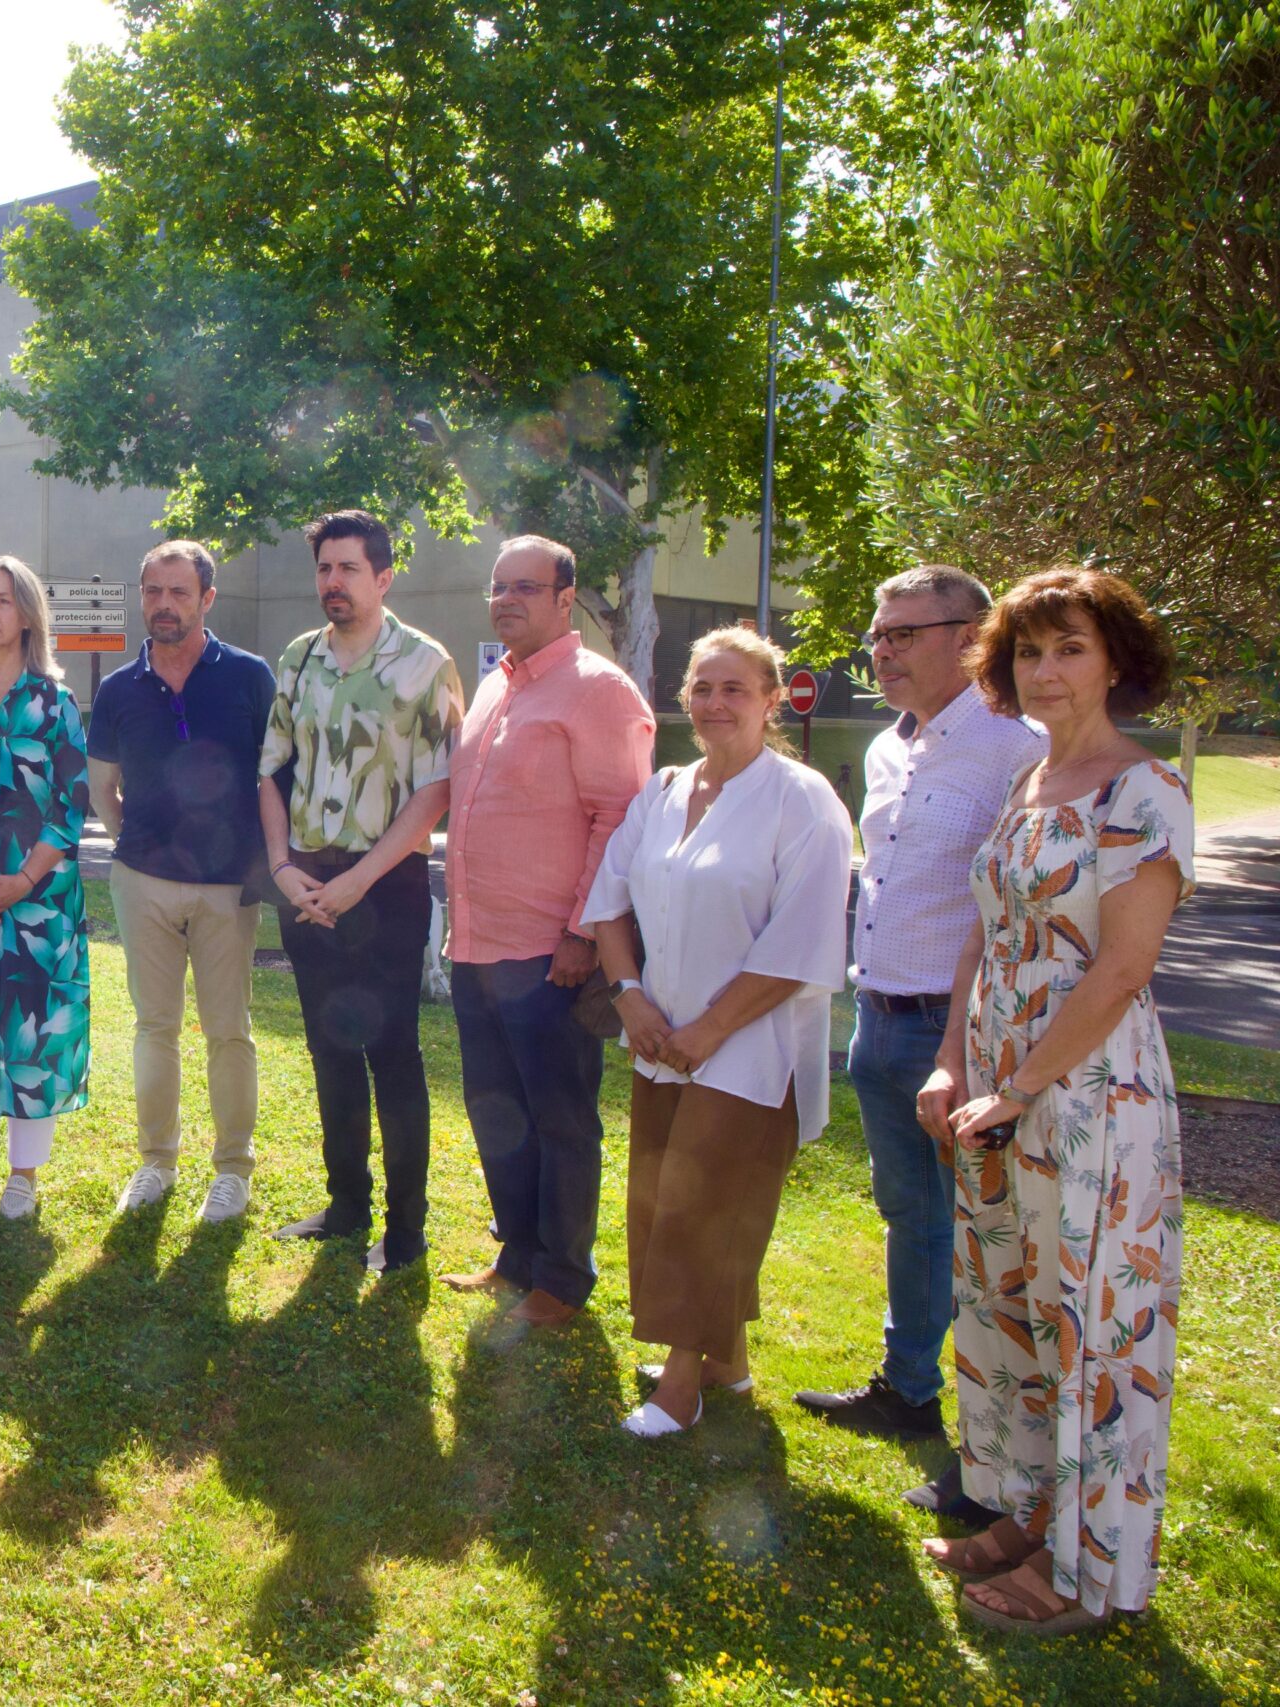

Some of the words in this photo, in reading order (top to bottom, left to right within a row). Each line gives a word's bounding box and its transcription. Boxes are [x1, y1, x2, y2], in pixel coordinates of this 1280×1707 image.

[101, 588, 123, 596] local
[55, 613, 102, 622] protección
[105, 613, 123, 621] civil
